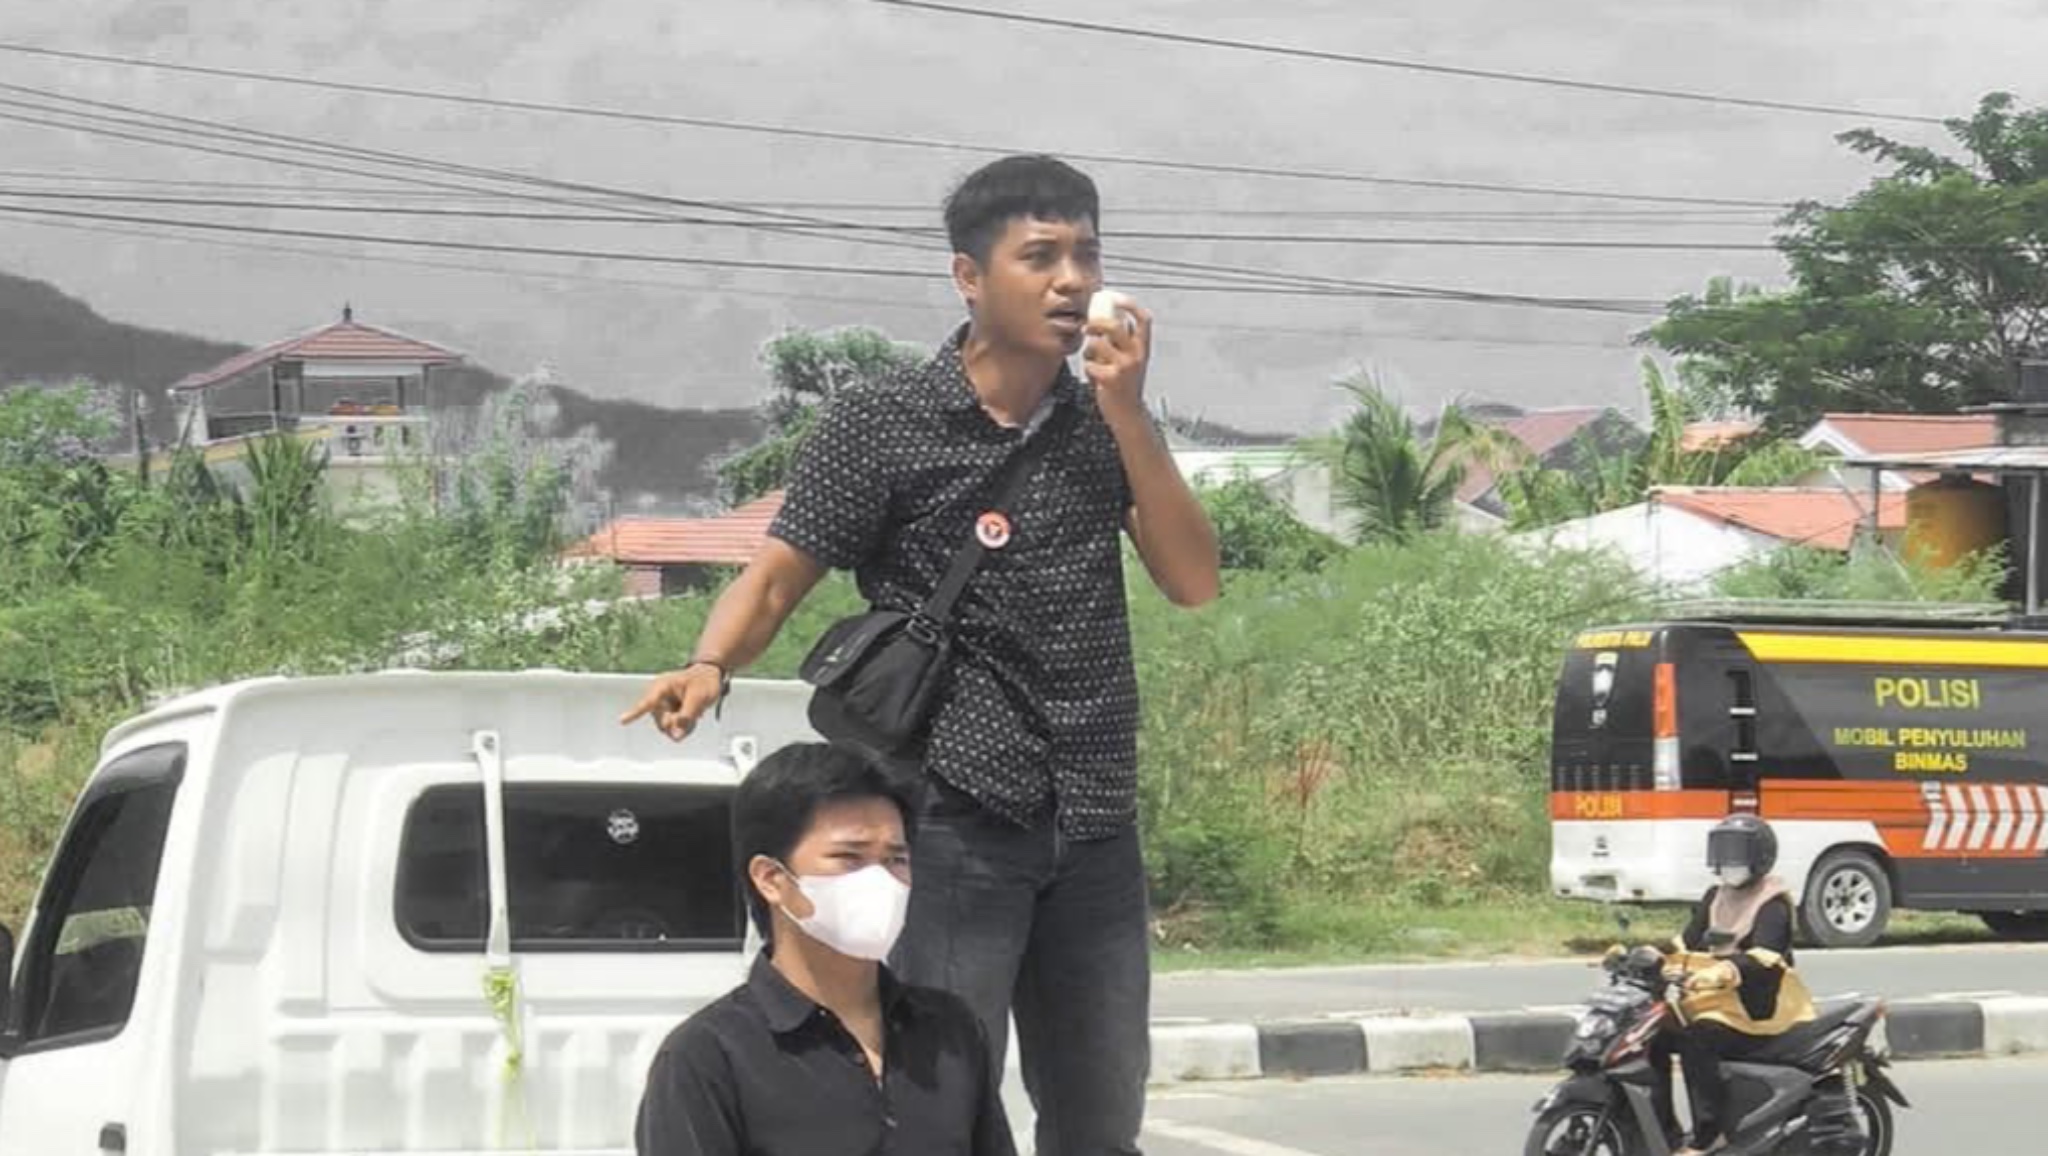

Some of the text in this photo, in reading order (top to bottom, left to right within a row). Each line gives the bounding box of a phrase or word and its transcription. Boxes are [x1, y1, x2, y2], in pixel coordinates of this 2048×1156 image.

[1874, 677, 1981, 709] POLISI
[1834, 727, 2026, 748] MOBIL PENYULUHAN
[1894, 751, 1968, 772] BINMAS
[1575, 792, 1623, 818] POLISI
